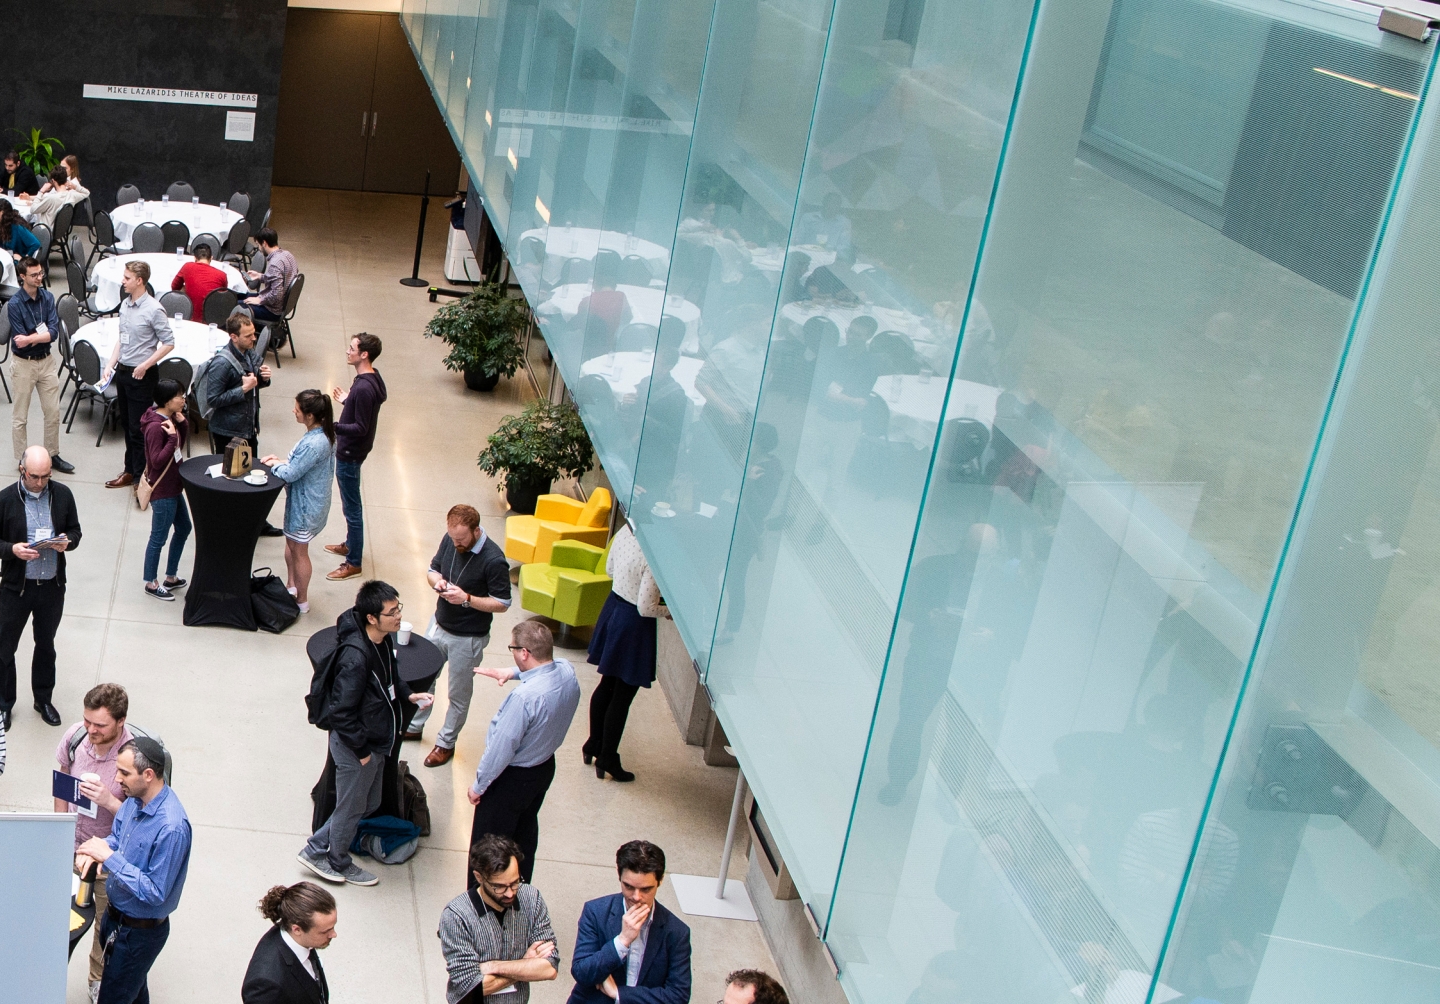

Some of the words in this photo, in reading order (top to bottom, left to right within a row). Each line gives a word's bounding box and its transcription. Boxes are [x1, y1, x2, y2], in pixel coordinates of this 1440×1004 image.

[131, 88, 176, 97] LAZARIDIS
[179, 90, 215, 99] THEATRE
[217, 92, 228, 100] OF
[231, 93, 257, 102] IDEAS
[242, 451, 249, 469] 2
